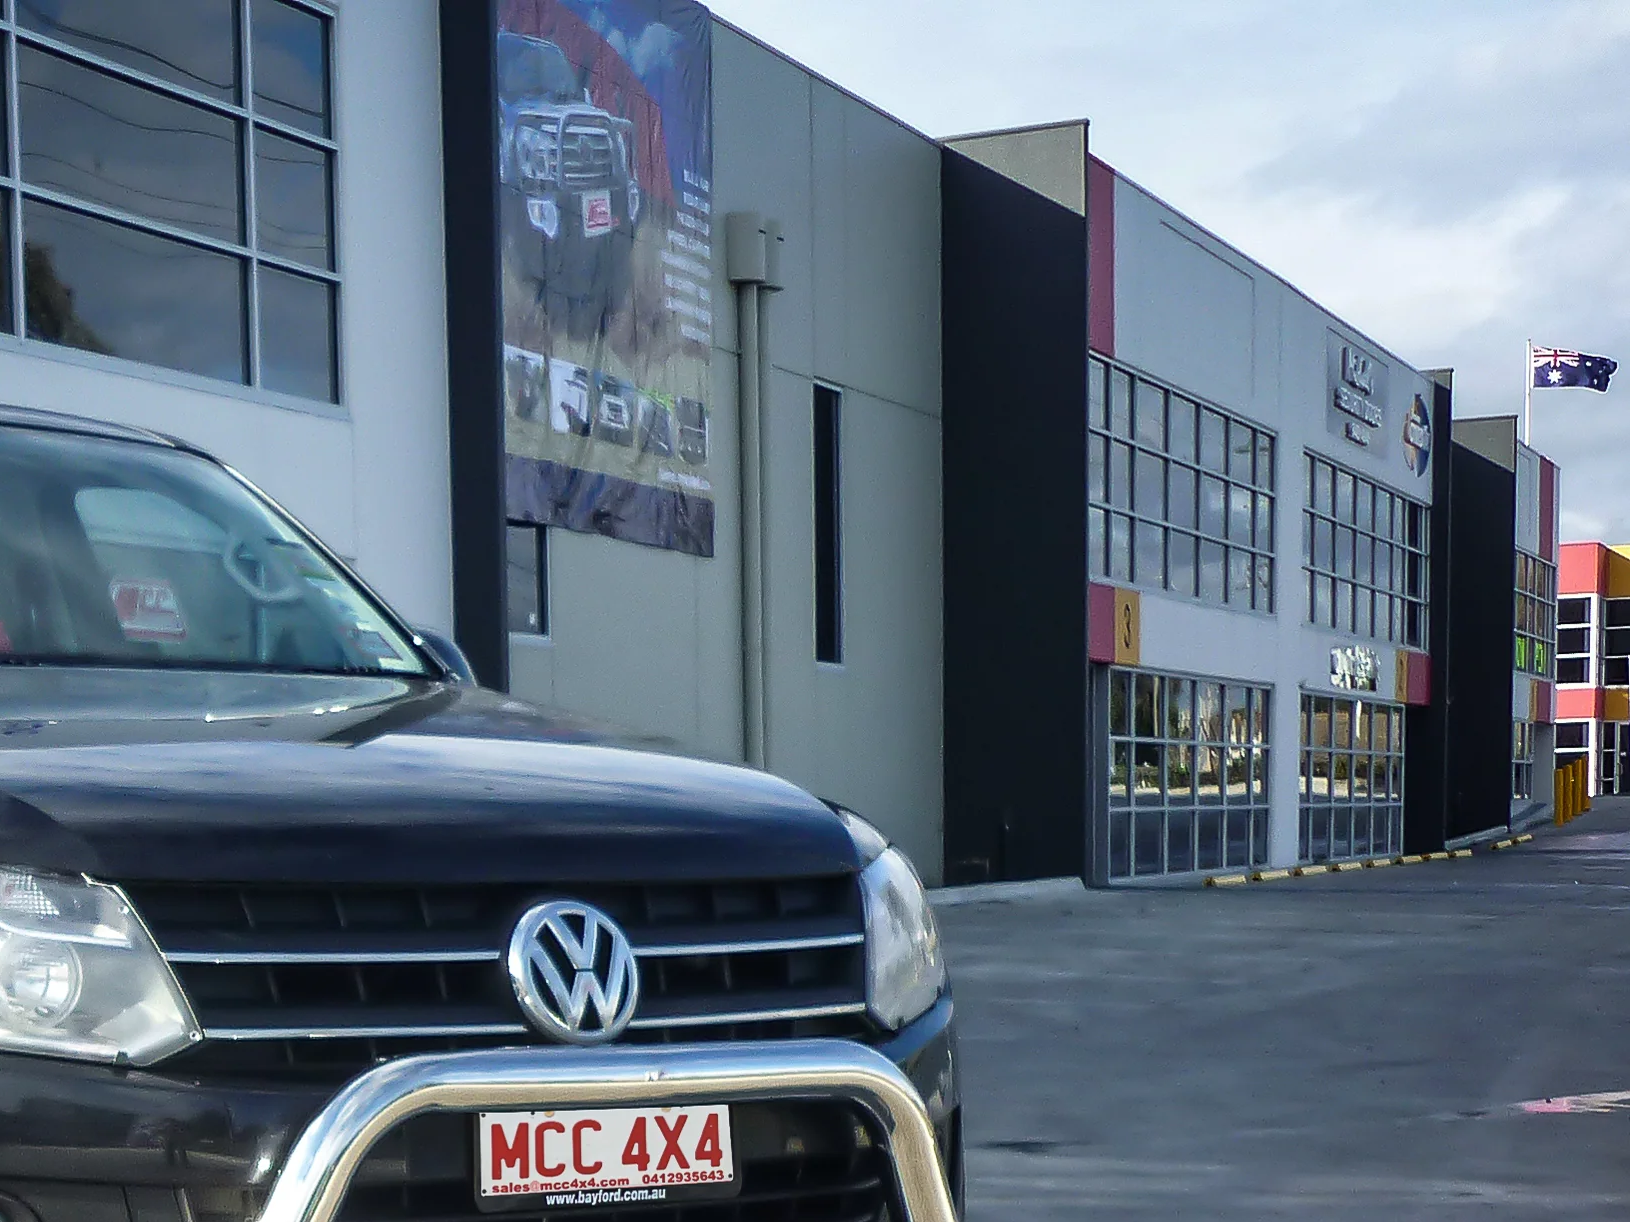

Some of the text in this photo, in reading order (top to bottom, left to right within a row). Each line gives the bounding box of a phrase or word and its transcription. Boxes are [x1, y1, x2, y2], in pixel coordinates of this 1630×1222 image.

[491, 1113, 723, 1181] MCC 4X4
[491, 1169, 725, 1194] sales@mcc4x4.com 0412935643
[545, 1187, 667, 1206] www.bayford.com.au
